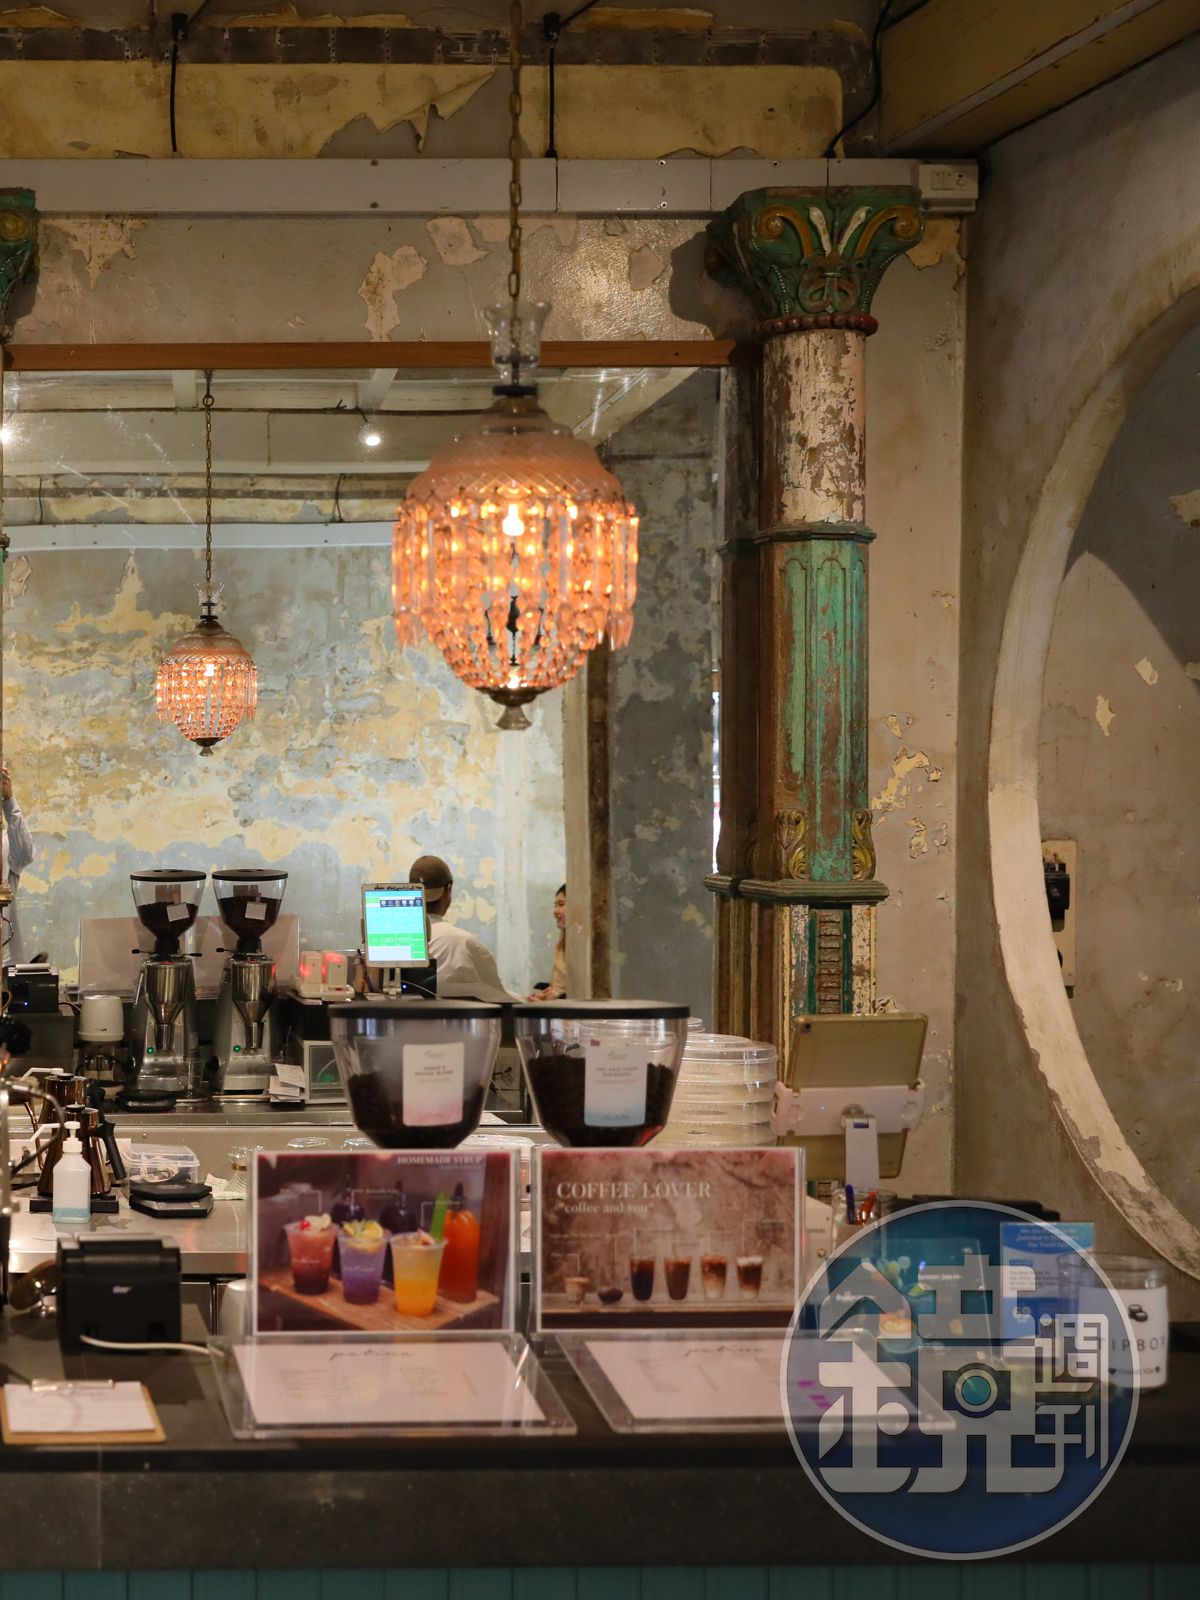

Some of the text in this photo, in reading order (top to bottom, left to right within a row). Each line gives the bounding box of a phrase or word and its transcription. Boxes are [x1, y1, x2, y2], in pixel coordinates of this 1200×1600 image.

[397, 1156, 483, 1165] HOMEMADE SYRUP
[556, 1181, 712, 1199] COFFEE LOVER
[603, 1201, 624, 1214] and
